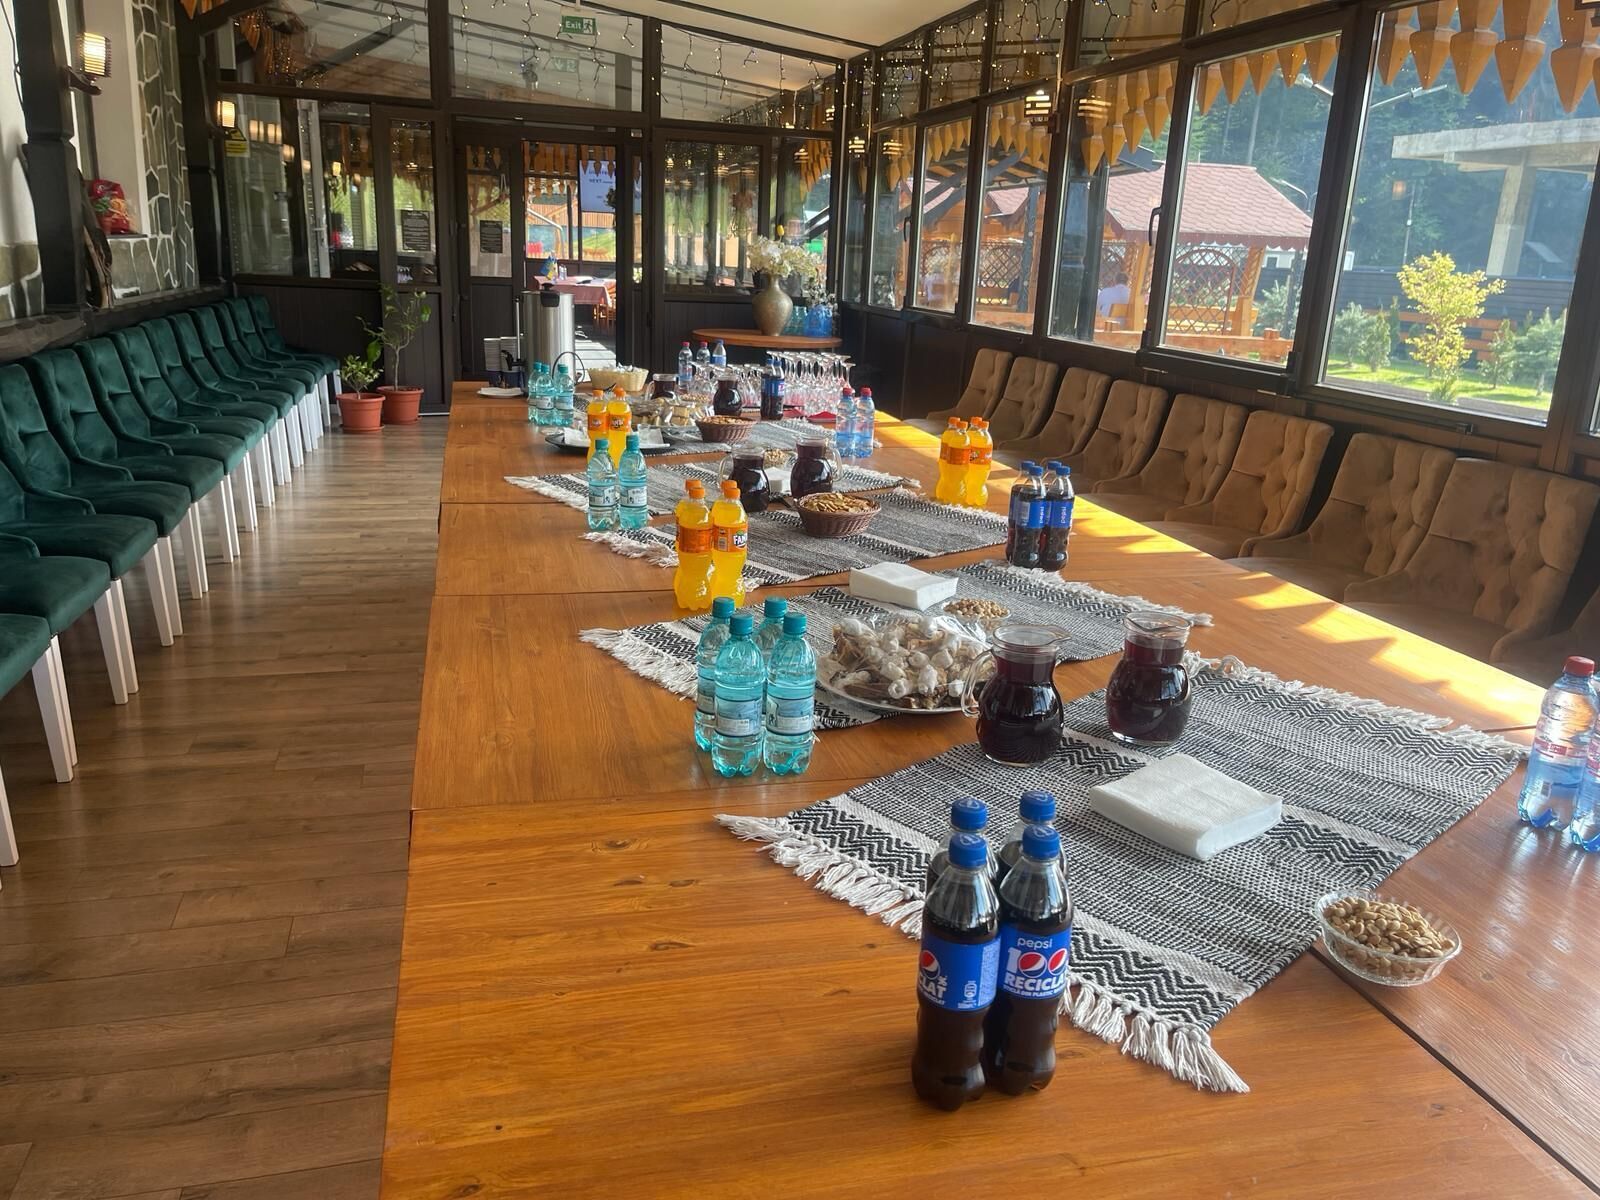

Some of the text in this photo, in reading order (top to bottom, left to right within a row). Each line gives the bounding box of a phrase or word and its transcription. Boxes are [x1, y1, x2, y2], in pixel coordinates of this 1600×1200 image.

[565, 20, 582, 30] Exit
[1017, 937, 1053, 950] pepsi
[1004, 970, 1066, 992] RECICLA
